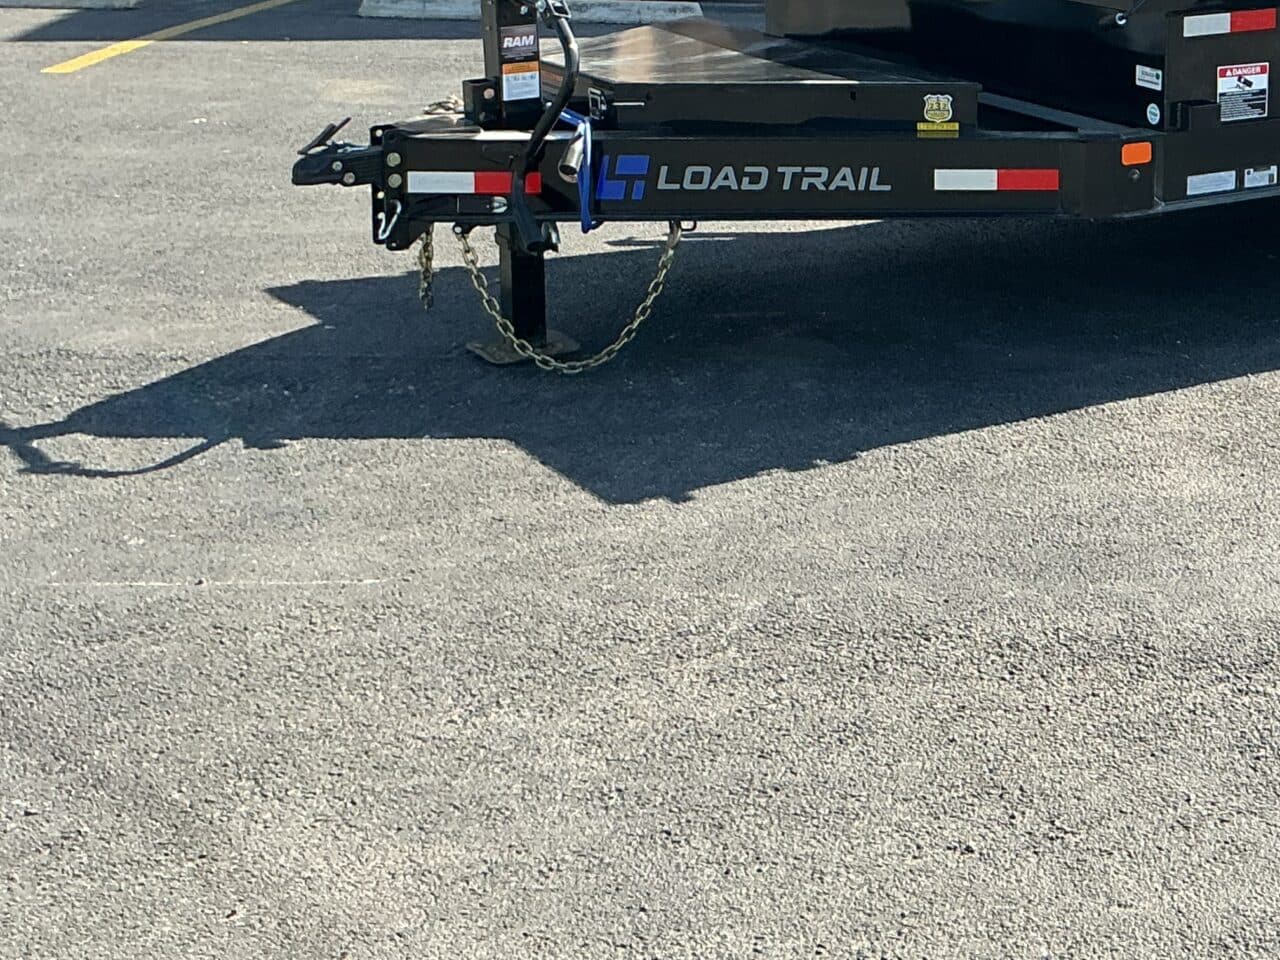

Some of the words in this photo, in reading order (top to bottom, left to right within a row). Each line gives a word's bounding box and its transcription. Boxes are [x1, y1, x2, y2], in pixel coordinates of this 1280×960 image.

[503, 35, 534, 48] RAM
[1232, 66, 1261, 75] DANGER
[656, 165, 770, 191] LOAD
[777, 166, 892, 191] TRAIL
